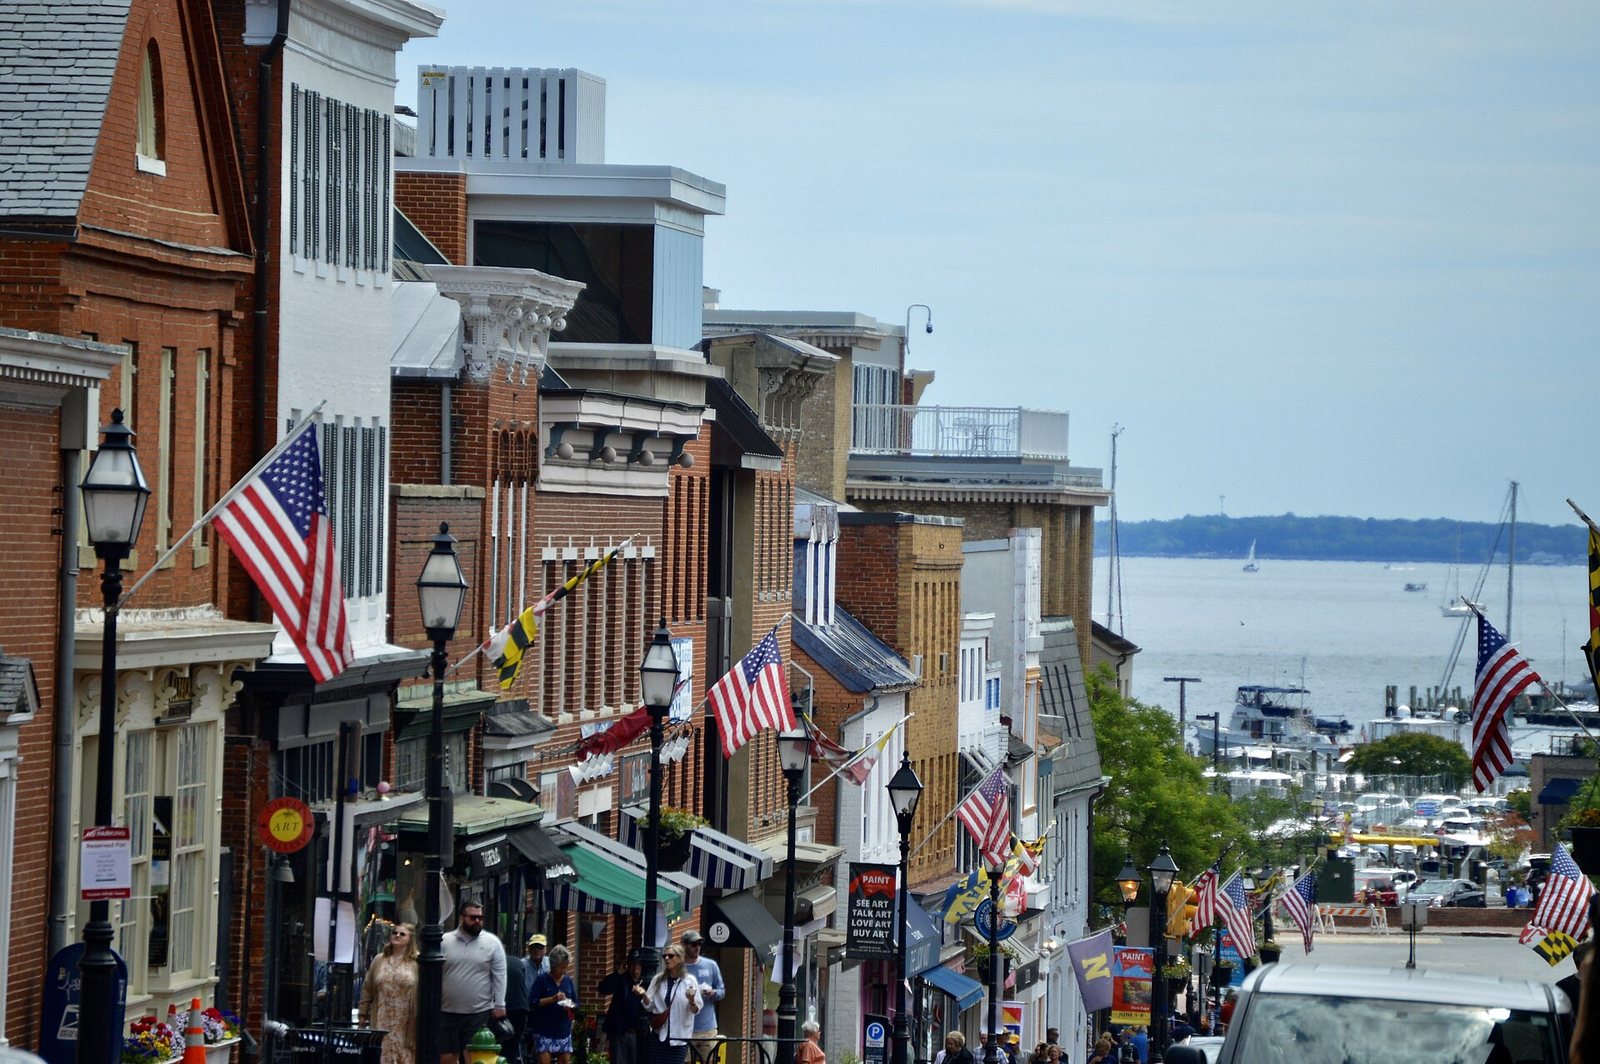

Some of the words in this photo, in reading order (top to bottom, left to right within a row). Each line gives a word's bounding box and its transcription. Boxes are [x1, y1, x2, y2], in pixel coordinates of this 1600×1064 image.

[273, 822, 300, 832] ART
[862, 875, 891, 885] PAINT
[856, 899, 871, 907] SEE
[871, 900, 889, 909] ART
[852, 909, 874, 918] TALK
[875, 910, 892, 919] ART
[851, 919, 874, 928] LOVE
[874, 920, 892, 929] ART
[716, 925, 723, 936] B
[853, 929, 871, 938] BUY
[872, 930, 890, 939] ART
[1122, 952, 1146, 961] PAINT
